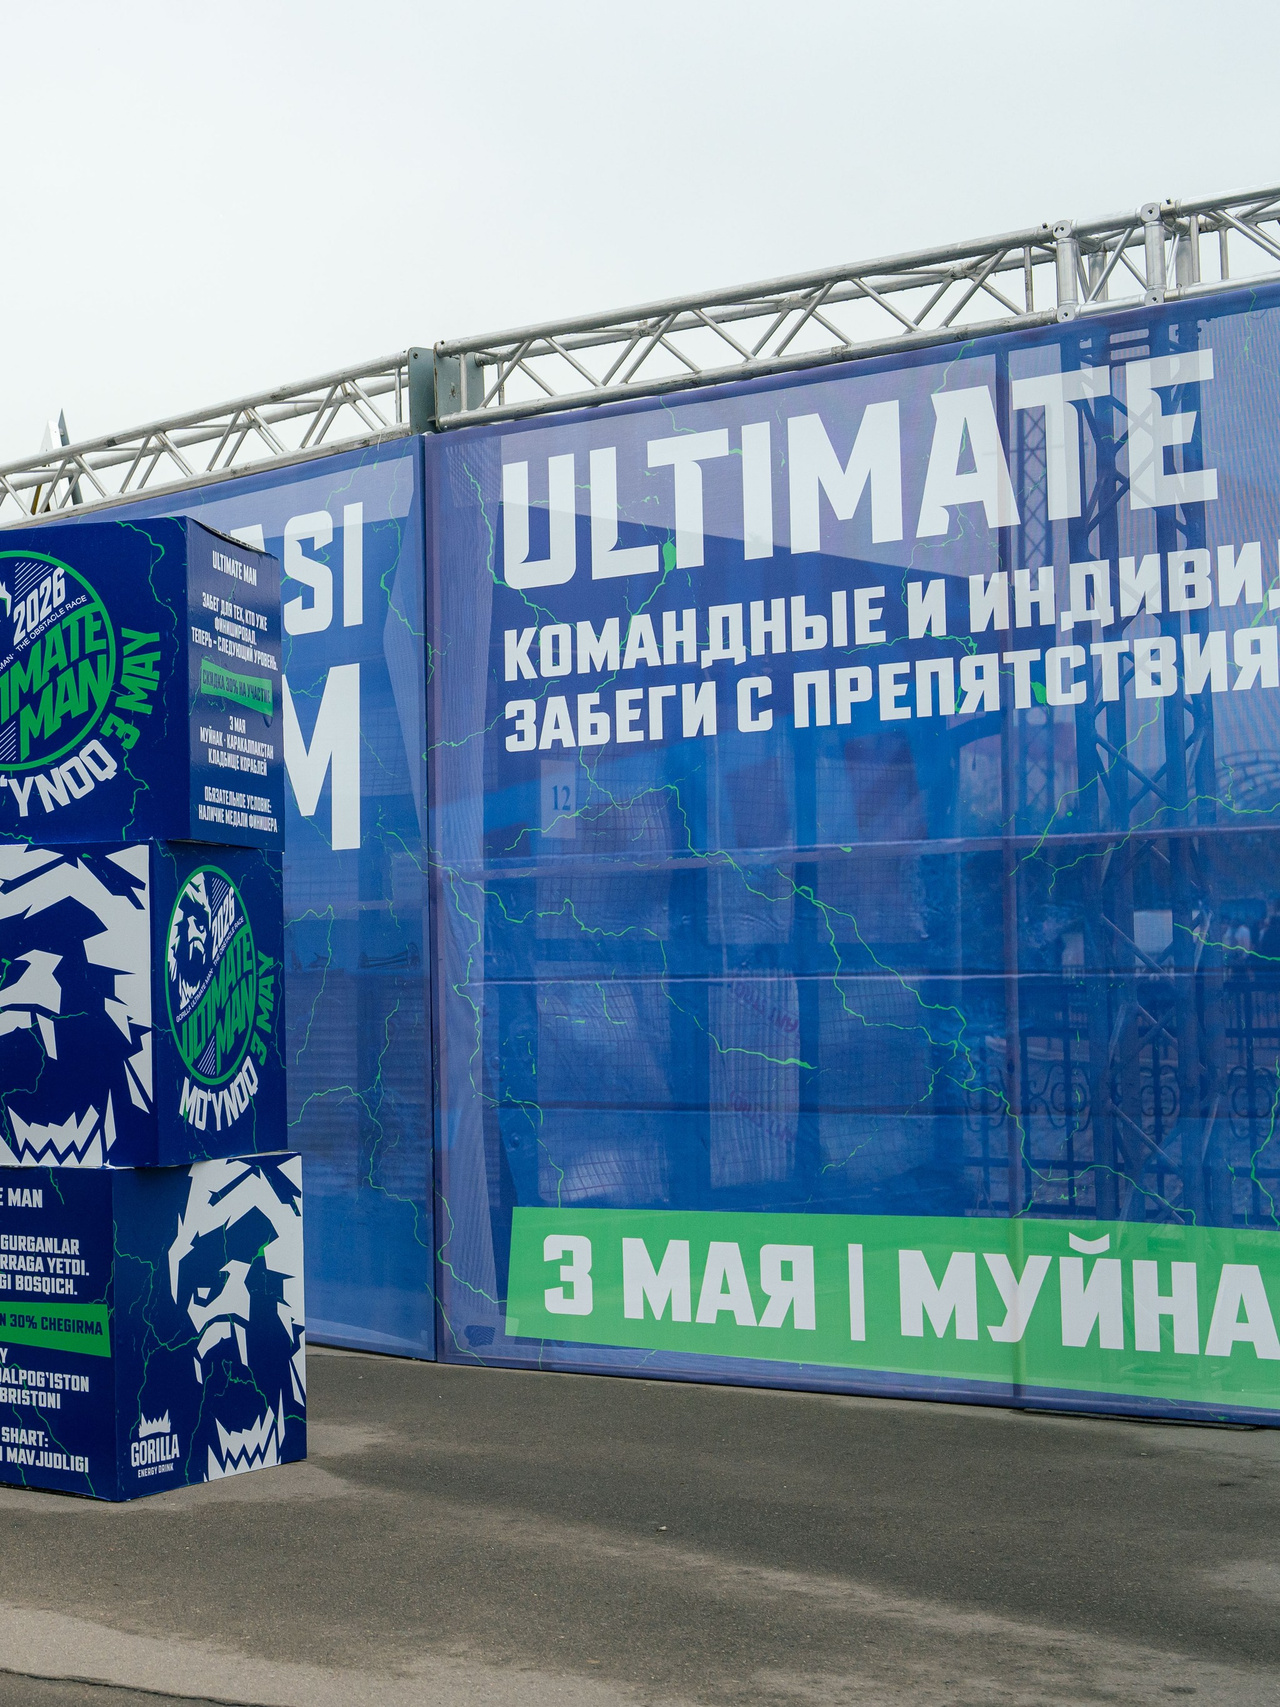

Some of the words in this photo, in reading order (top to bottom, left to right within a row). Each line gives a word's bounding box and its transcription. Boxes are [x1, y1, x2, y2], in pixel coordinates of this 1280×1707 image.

[500, 348, 1218, 591] ULTIMATE
[212, 550, 243, 580] ULTIMATE
[243, 564, 257, 587] MAN
[13, 566, 66, 646] 2026
[15, 639, 31, 652] THE
[29, 609, 66, 640] OBSTACLE
[65, 594, 88, 611] RACE
[202, 592, 220, 613] ЗАБЕГ
[220, 600, 233, 618] ДЛЯ
[244, 609, 256, 627] КТО
[255, 614, 268, 632] УЖЕ
[503, 585, 888, 682] КОМАНДНЫЕ
[907, 577, 947, 640] И
[969, 539, 1280, 630] ИНДИВИ
[191, 626, 213, 648] ТЕПЕРЬ
[217, 636, 253, 663] СЛЕДУЮЩИЙ
[253, 648, 279, 671] УРОВЕНЬ.
[114, 627, 161, 715] MAY
[202, 669, 225, 691] СКИДКА
[238, 681, 246, 698] НА
[503, 679, 717, 752] ЗАБЕГИ
[735, 675, 774, 733] С
[794, 626, 1280, 728] ПРЕПЯТСТВИЯ
[20, 654, 107, 762] MAN
[234, 716, 246, 734] МАЯ
[99, 712, 141, 750] 3
[199, 725, 224, 747] МУЙНАК
[226, 733, 274, 760] КАРАКАЛПАКСТАН
[208, 748, 240, 772] КЛАДБИЩЕ
[239, 755, 268, 777] КОРАБЛЕЙ
[204, 785, 246, 809] ОБЯЗАТЕЛЬНОЕ
[551, 785, 571, 811] 12
[198, 803, 225, 824] НАЛИЧИЕ
[225, 809, 249, 828] МЕДАЛИ
[248, 813, 278, 833] ФИНИШЕРА
[211, 886, 235, 961] 2026
[176, 1005, 192, 1023] GORILLA
[191, 985, 206, 1008] ULTIMATE
[234, 915, 244, 929] RACE
[181, 931, 253, 1067] ULTIMATE
[256, 950, 275, 1033] MAY
[216, 974, 253, 1075] MAN
[250, 1031, 267, 1066] 3
[7, 1187, 43, 1209] MAN
[15, 1275, 78, 1296] BOSQICH.
[46, 1257, 90, 1277] YETDI.
[542, 1233, 594, 1317] 3
[621, 1237, 817, 1332] МАЯ
[898, 1231, 1280, 1360] МУЙНА
[9, 1313, 38, 1330] 30%
[40, 1316, 103, 1336] CHEGIRMA
[1, 1426, 49, 1448] SHART:
[130, 1433, 180, 1468] GORILLA
[6, 1446, 89, 1474] MAVJUDLIGI
[137, 1465, 158, 1479] ENERGY
[158, 1462, 174, 1474] DRINK
